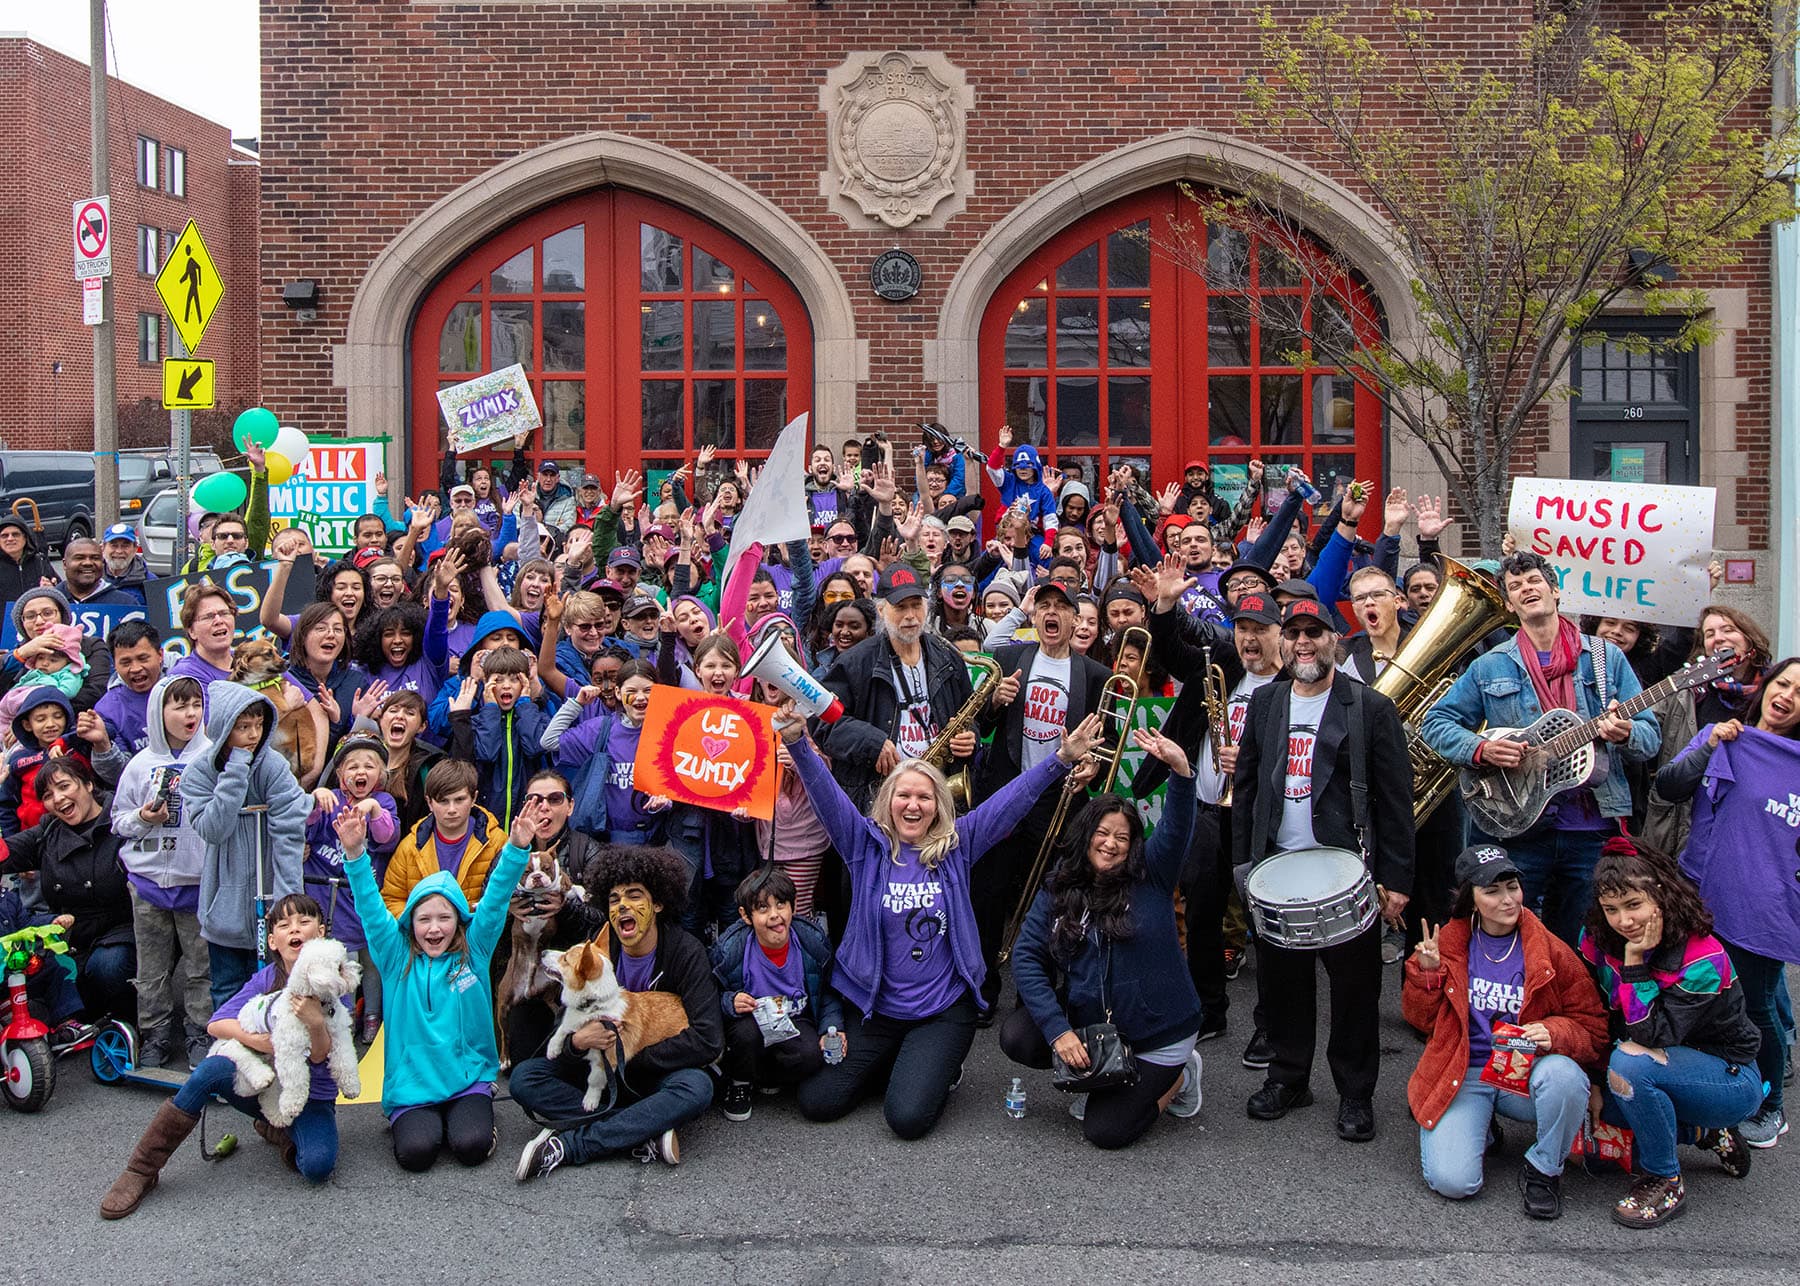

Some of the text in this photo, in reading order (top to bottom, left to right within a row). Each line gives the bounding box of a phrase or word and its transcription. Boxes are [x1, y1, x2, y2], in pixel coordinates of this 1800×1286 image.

[865, 72, 927, 89] BOSTON
[884, 198, 912, 216] 40
[86, 260, 109, 270] TRUCKS
[458, 388, 519, 427] ZUMIX
[1623, 407, 1643, 420] 260
[297, 450, 359, 479] ALK
[286, 475, 305, 487] FOR
[268, 486, 359, 513] MUSIC
[300, 512, 319, 524] THE
[1535, 495, 1663, 533] MUSIC
[1531, 527, 1647, 566] SAVED
[1553, 564, 1656, 607] Y LIFE
[1030, 685, 1059, 706] HOT
[701, 710, 741, 738] WE
[1024, 700, 1066, 727] AMALE
[1038, 728, 1060, 739] BAND
[1287, 737, 1313, 758] HOT
[674, 751, 750, 792] ZUMIX
[888, 882, 942, 897] WALK
